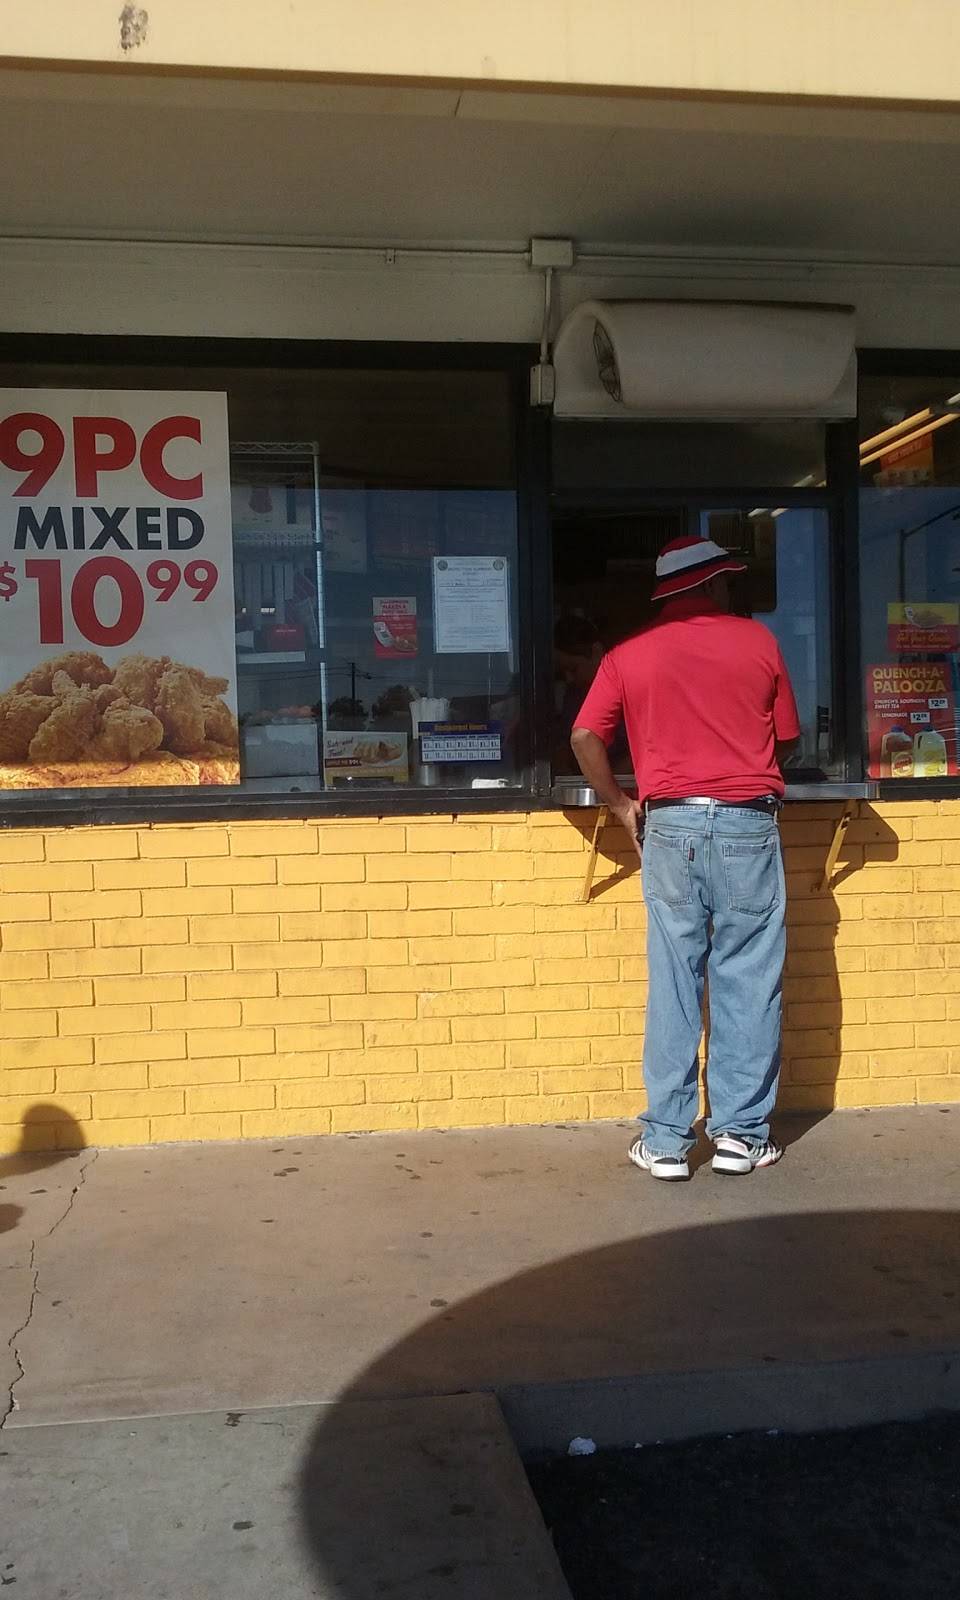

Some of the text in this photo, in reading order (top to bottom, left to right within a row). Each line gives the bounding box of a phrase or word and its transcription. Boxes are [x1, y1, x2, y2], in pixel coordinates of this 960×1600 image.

[13, 506, 205, 551] MIXED
[872, 667, 945, 680] QUENCH-A-
[873, 680, 948, 694] PALOOZA
